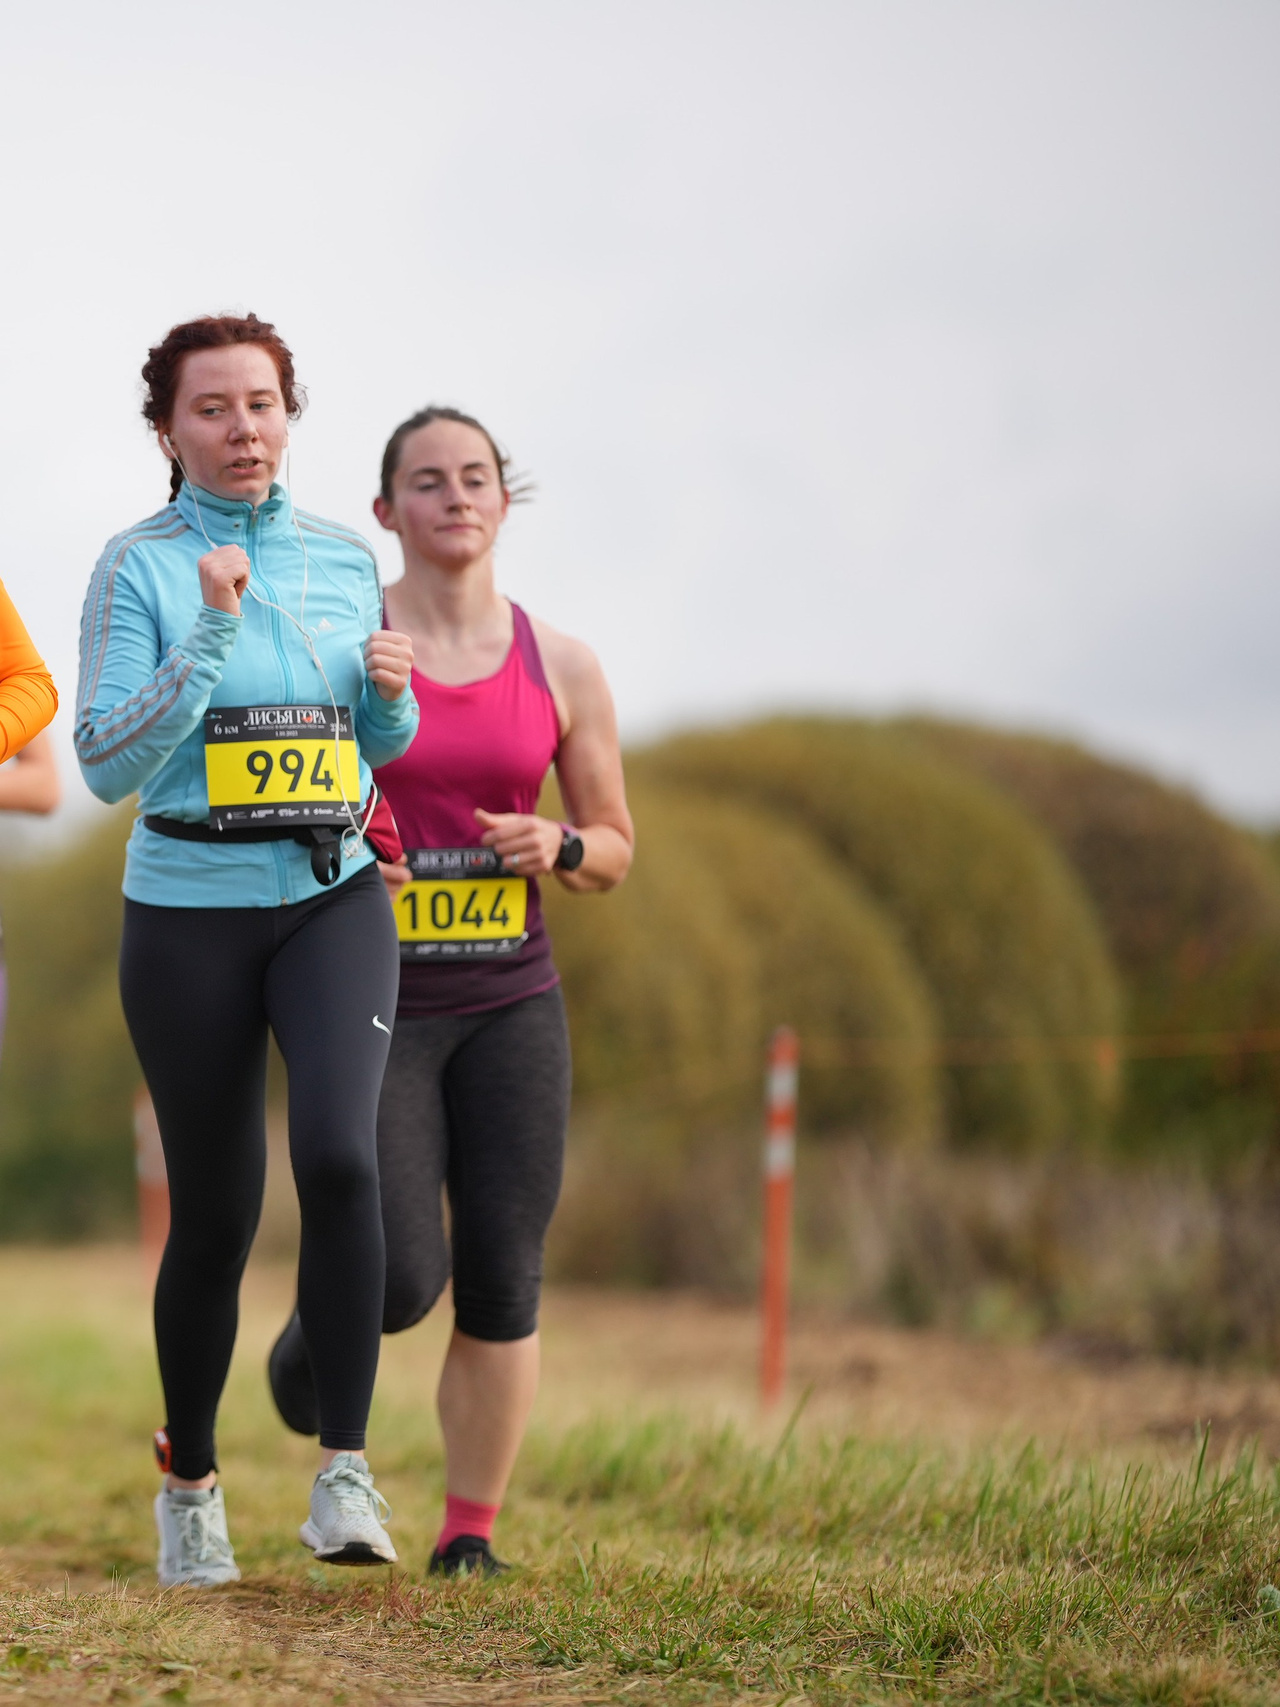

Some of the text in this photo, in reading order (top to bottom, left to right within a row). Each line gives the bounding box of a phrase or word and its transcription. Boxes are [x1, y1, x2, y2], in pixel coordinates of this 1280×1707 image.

[214, 723, 222, 735] 6
[243, 709, 327, 727] ЛИСЬЯ ГОРА
[246, 749, 334, 794] 994
[402, 888, 510, 931] 1044
